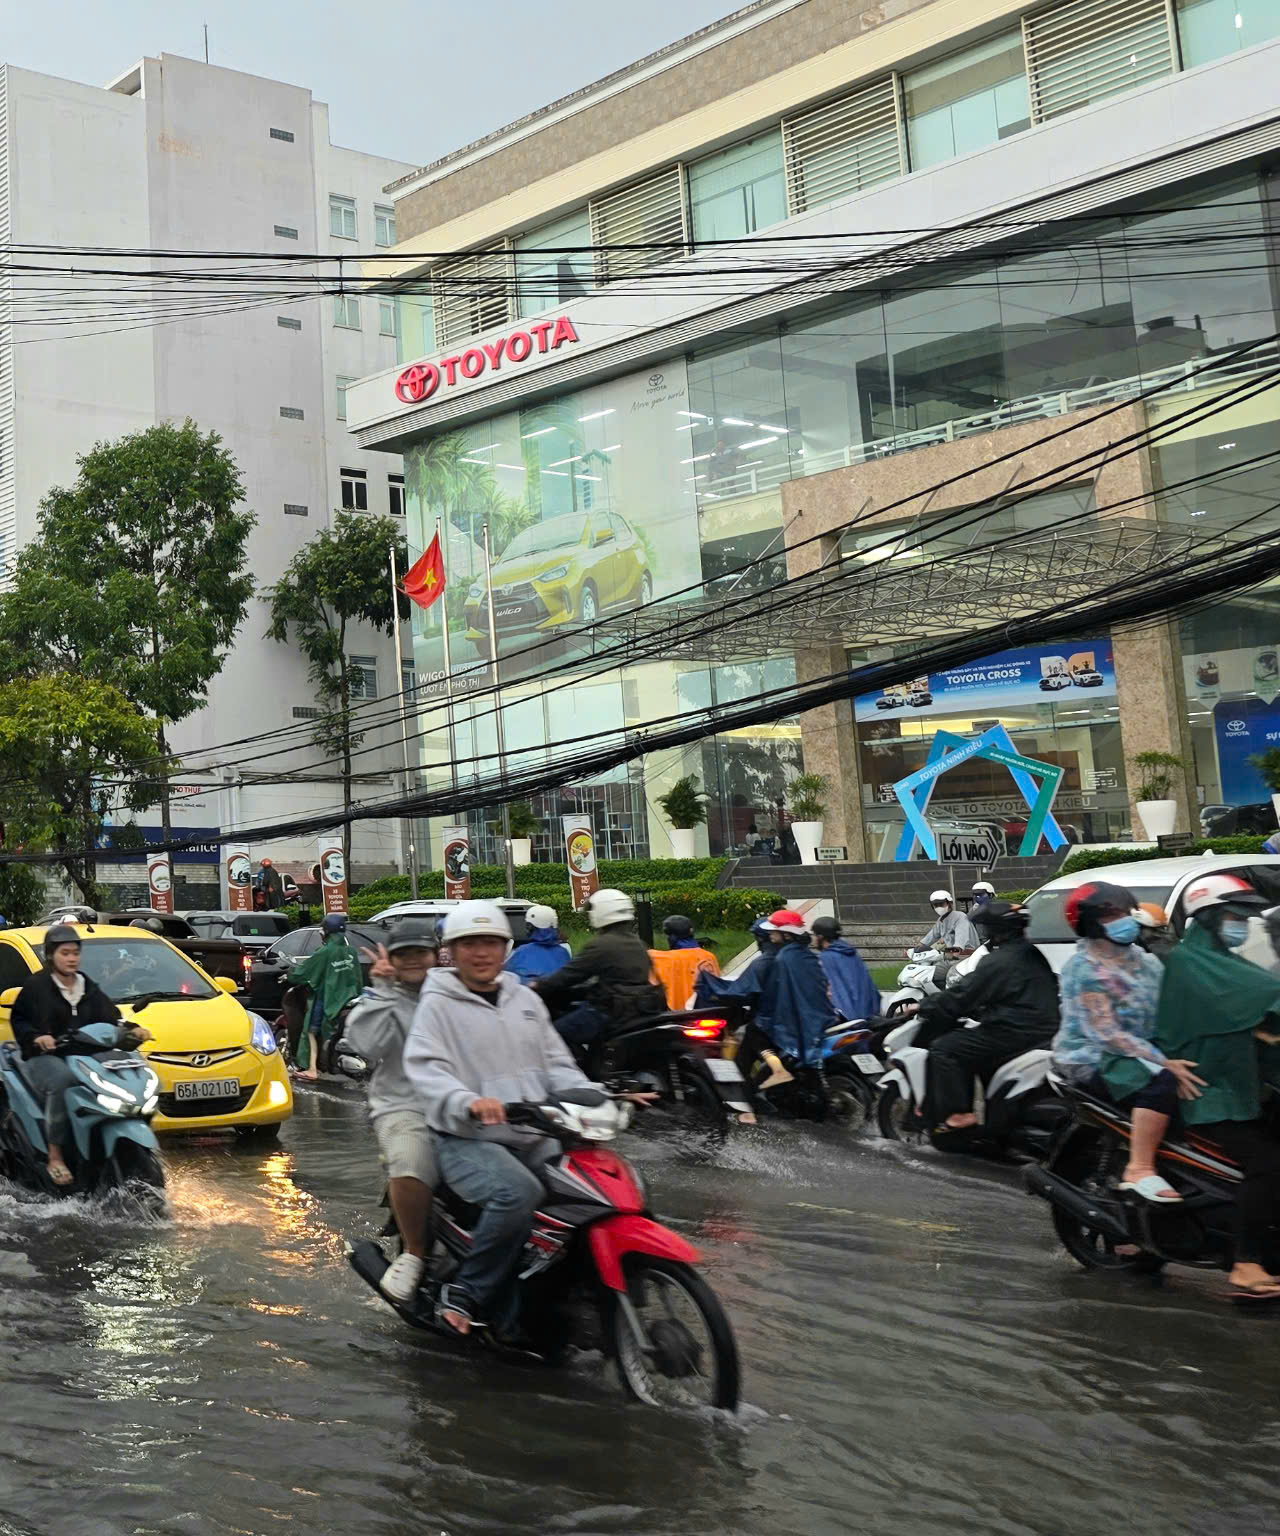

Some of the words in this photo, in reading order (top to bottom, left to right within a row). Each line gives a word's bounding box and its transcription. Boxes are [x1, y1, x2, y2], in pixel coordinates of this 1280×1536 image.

[440, 315, 579, 386] TOYOTA
[647, 385, 668, 394] TOYOTA
[946, 672, 986, 685] TOYOTA
[987, 668, 1022, 680] CROSS
[1225, 730, 1250, 738] TOYOTA
[919, 761, 947, 781] TOYOTA
[946, 750, 966, 766] NINH
[962, 803, 978, 815] TO
[982, 800, 1027, 812] TOYOTA
[942, 836, 962, 861] LỐI
[964, 839, 989, 862] VÀO
[177, 1081, 238, 1099] 65A-021.03
